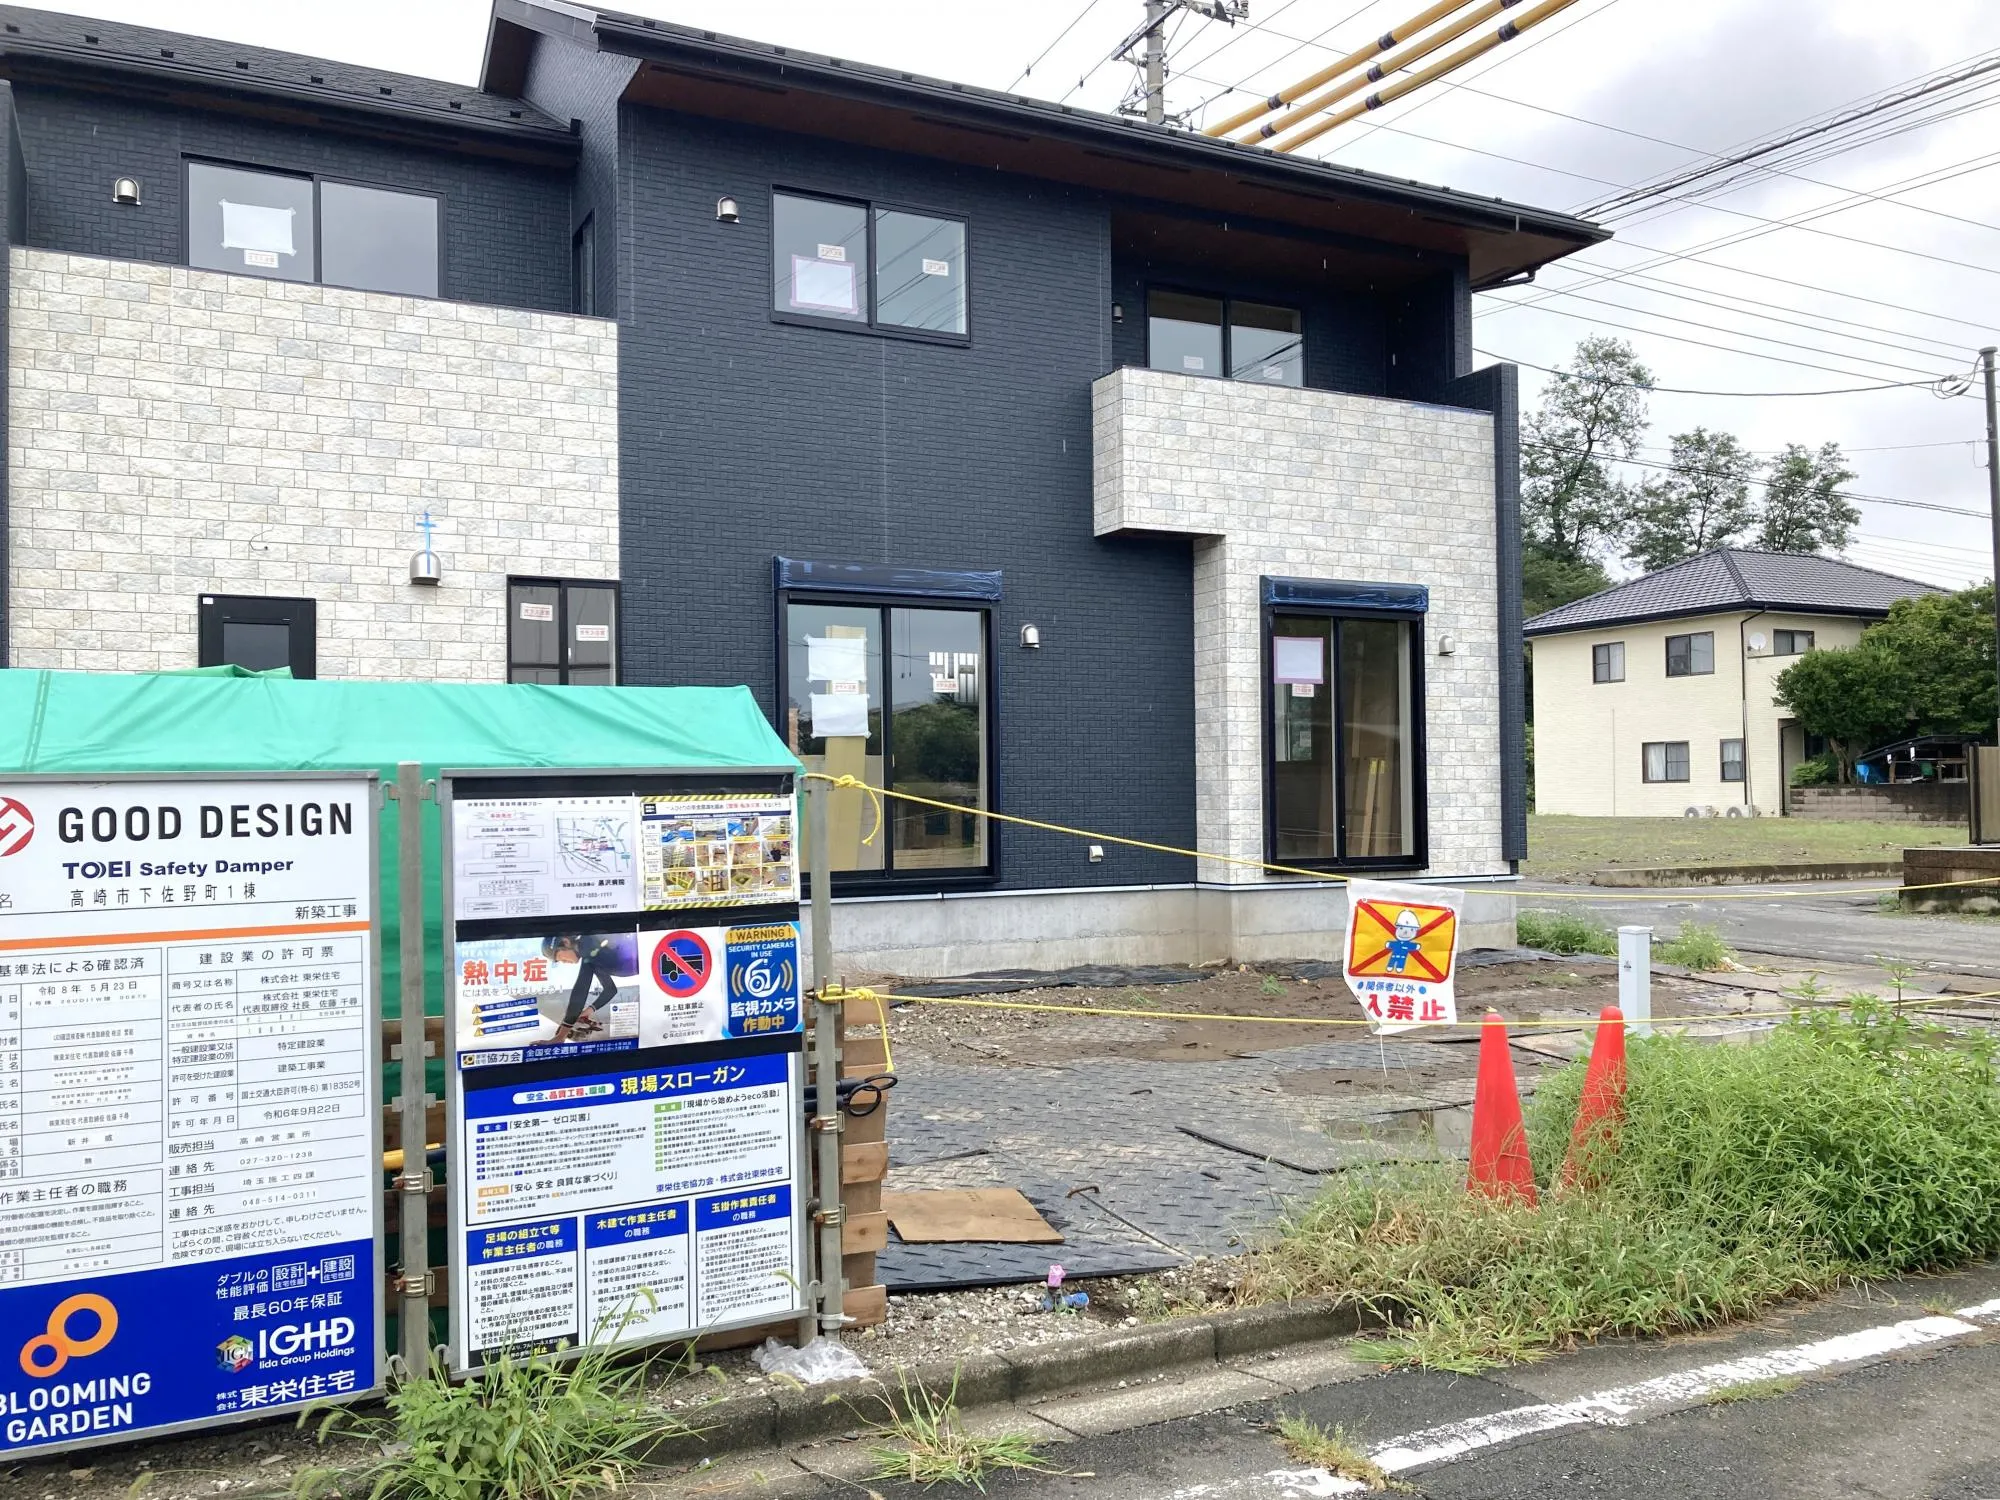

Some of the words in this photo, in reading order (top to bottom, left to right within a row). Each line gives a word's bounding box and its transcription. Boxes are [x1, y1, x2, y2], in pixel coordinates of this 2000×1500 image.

[58, 806, 182, 843] GOOD
[200, 802, 352, 839] DESIGN
[139, 860, 208, 878] Safety
[215, 858, 294, 876] Damper
[294, 903, 357, 920] 新築工事
[736, 928, 786, 941] WARNING
[728, 944, 761, 953] SECURITY
[762, 941, 795, 950] CAMERAS
[199, 946, 334, 966] 建設業の許可票
[260, 973, 299, 985] 株式会社
[302, 971, 341, 982] 東栄住宅
[463, 957, 549, 986] 熱中症
[171, 977, 233, 990] 商号又は名称
[1365, 981, 1416, 994] 関係者以外
[263, 991, 299, 1002] 株式会社
[302, 988, 339, 999] 東栄住宅
[171, 1000, 234, 1014] 代表者の氏名
[730, 996, 796, 1018] 監視カメラ
[1367, 993, 1448, 1021] 入禁止
[743, 1015, 785, 1033] 作動中
[276, 1038, 326, 1051] 特定建設業
[487, 1052, 521, 1063] 協力会
[277, 1060, 326, 1073] 建築工事業
[620, 1065, 746, 1096] 現場スローガン
[171, 1092, 235, 1106] 許可番号
[263, 1103, 341, 1120] 令和6年9月22日
[171, 1114, 235, 1130] 許可年月日
[168, 1139, 215, 1155] 販売担当
[239, 1150, 313, 1166] 027-320-1238
[168, 1161, 215, 1176] 連絡先
[169, 1183, 215, 1197] 工事担当
[535, 1179, 553, 1190] 安全
[168, 1204, 215, 1220] 連絡先
[596, 1209, 677, 1230] 木建て作業主任者
[733, 1210, 756, 1221] の職務
[485, 1224, 561, 1244] 足場の組立て等
[624, 1226, 650, 1238] の職務
[482, 1238, 564, 1259] 作業主任者の職務
[275, 1264, 304, 1281] 設計
[323, 1258, 352, 1274] 建設
[217, 1269, 269, 1287] ダブルの
[215, 1281, 269, 1300] 性能評価
[233, 1290, 344, 1321] 最長60年保証
[259, 1316, 355, 1359] IGHD
[280, 1354, 312, 1366] Group
[313, 1346, 355, 1364] Holdings
[216, 1390, 238, 1401] 株式
[239, 1369, 356, 1410] 東栄住宅
[216, 1401, 238, 1412] 会社
[7, 1402, 133, 1443] GARDEN
